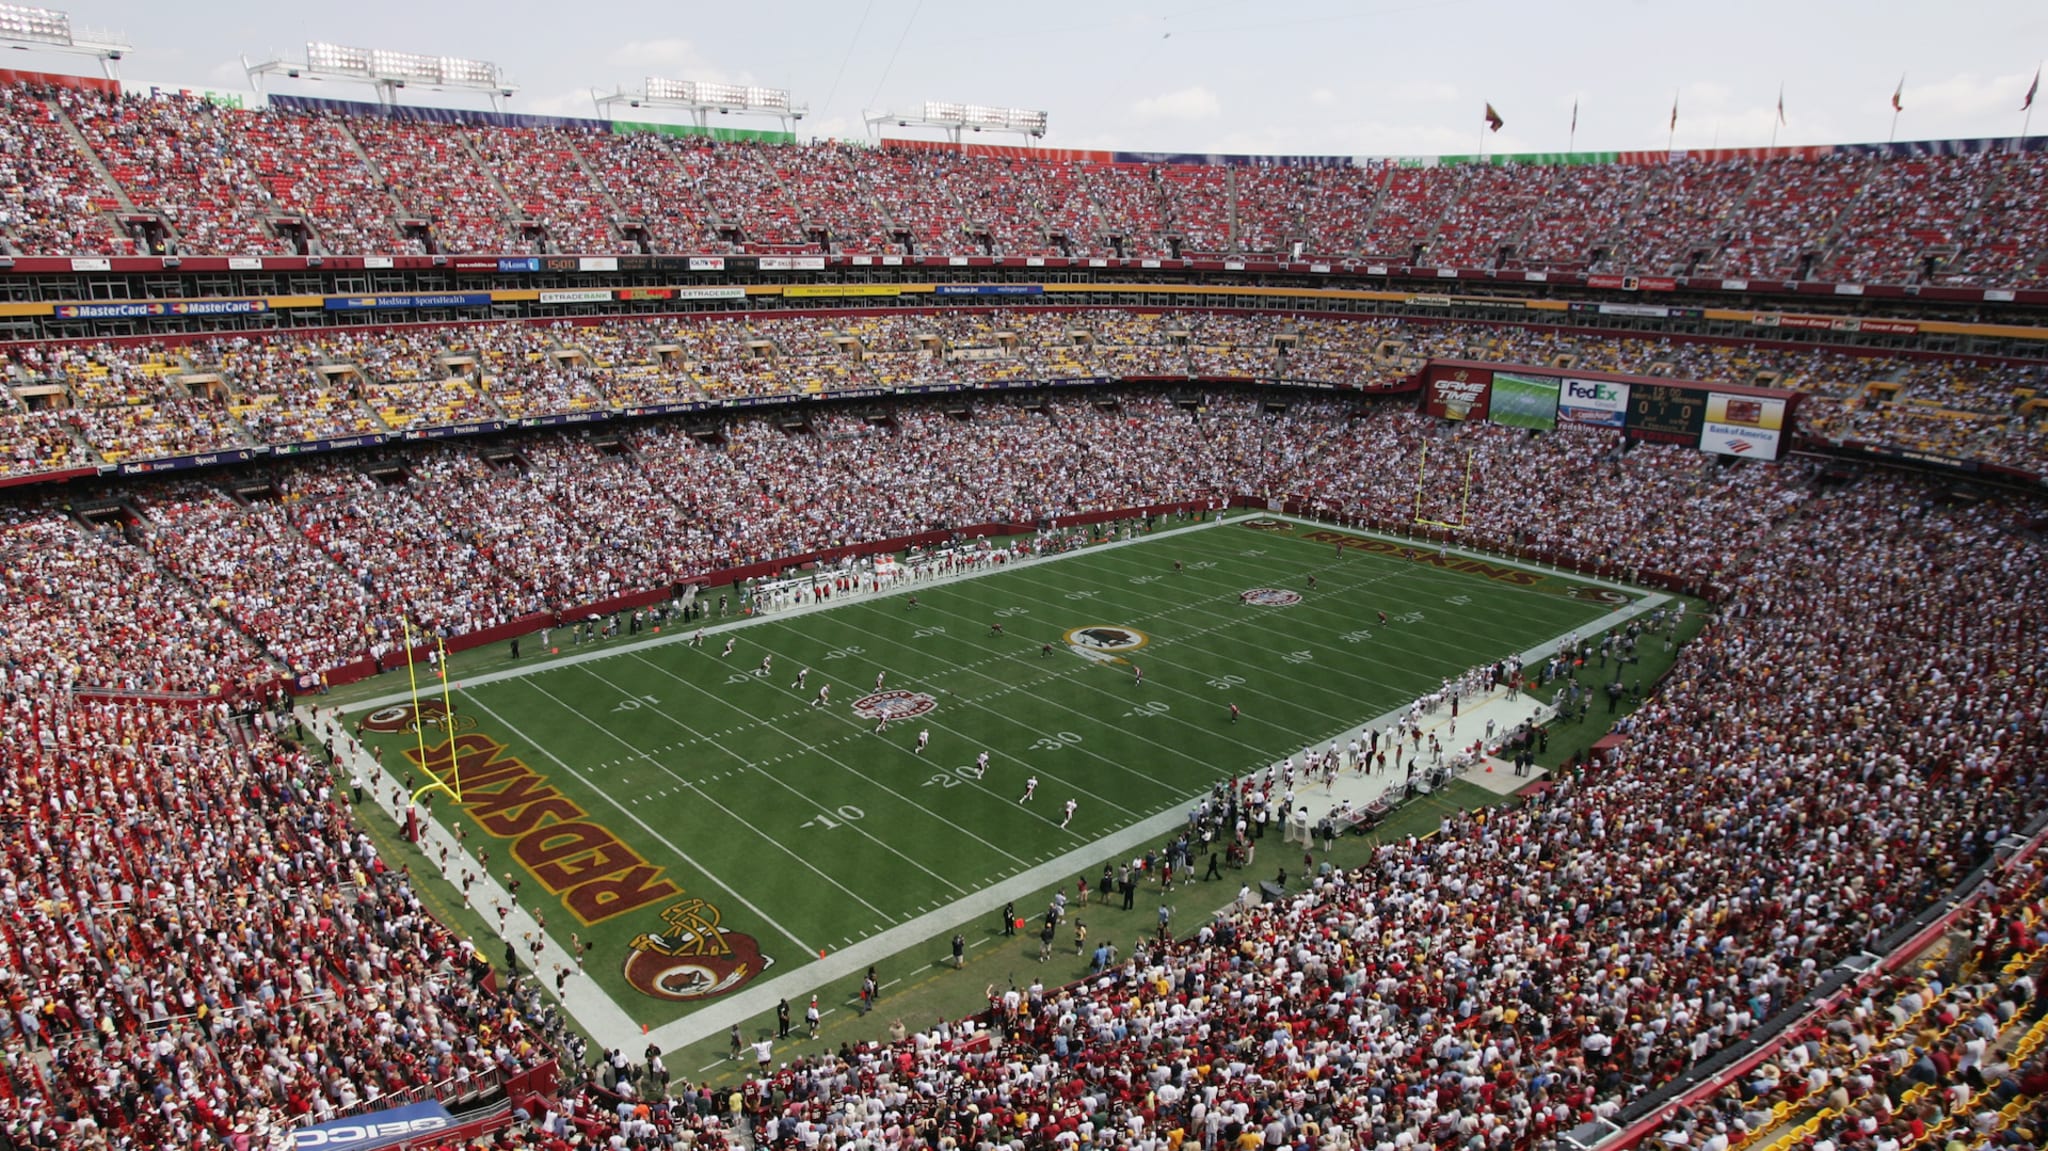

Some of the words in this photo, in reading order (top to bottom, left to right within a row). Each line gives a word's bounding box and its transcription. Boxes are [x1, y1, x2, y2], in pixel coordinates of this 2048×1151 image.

[80, 304, 147, 317] MasterCard
[189, 302, 250, 313] MasterCard
[378, 297, 411, 305] MedStar
[415, 296, 465, 307] SportsHealth
[1434, 380, 1487, 393] GAME
[1439, 390, 1479, 402] TIME
[1568, 382, 1617, 401] FedEx
[406, 430, 427, 440] FedEx
[454, 426, 480, 434] Precision
[1710, 425, 1731, 435] Bank
[1731, 427, 1740, 436] of
[1740, 429, 1773, 441] America
[275, 444, 299, 454] FedEx
[329, 438, 362, 449] Teamwork
[124, 463, 152, 474] FedEx
[195, 455, 217, 466] Speed
[1300, 531, 1545, 586] REDSKINS
[1206, 673, 1247, 691] 50
[617, 693, 662, 712] 10
[1133, 700, 1171, 719] 40
[1037, 731, 1083, 751] 30
[931, 765, 980, 789] 20
[812, 804, 866, 831] 10
[402, 733, 685, 927] REDSKINS
[286, 1116, 448, 1148] GEICO
